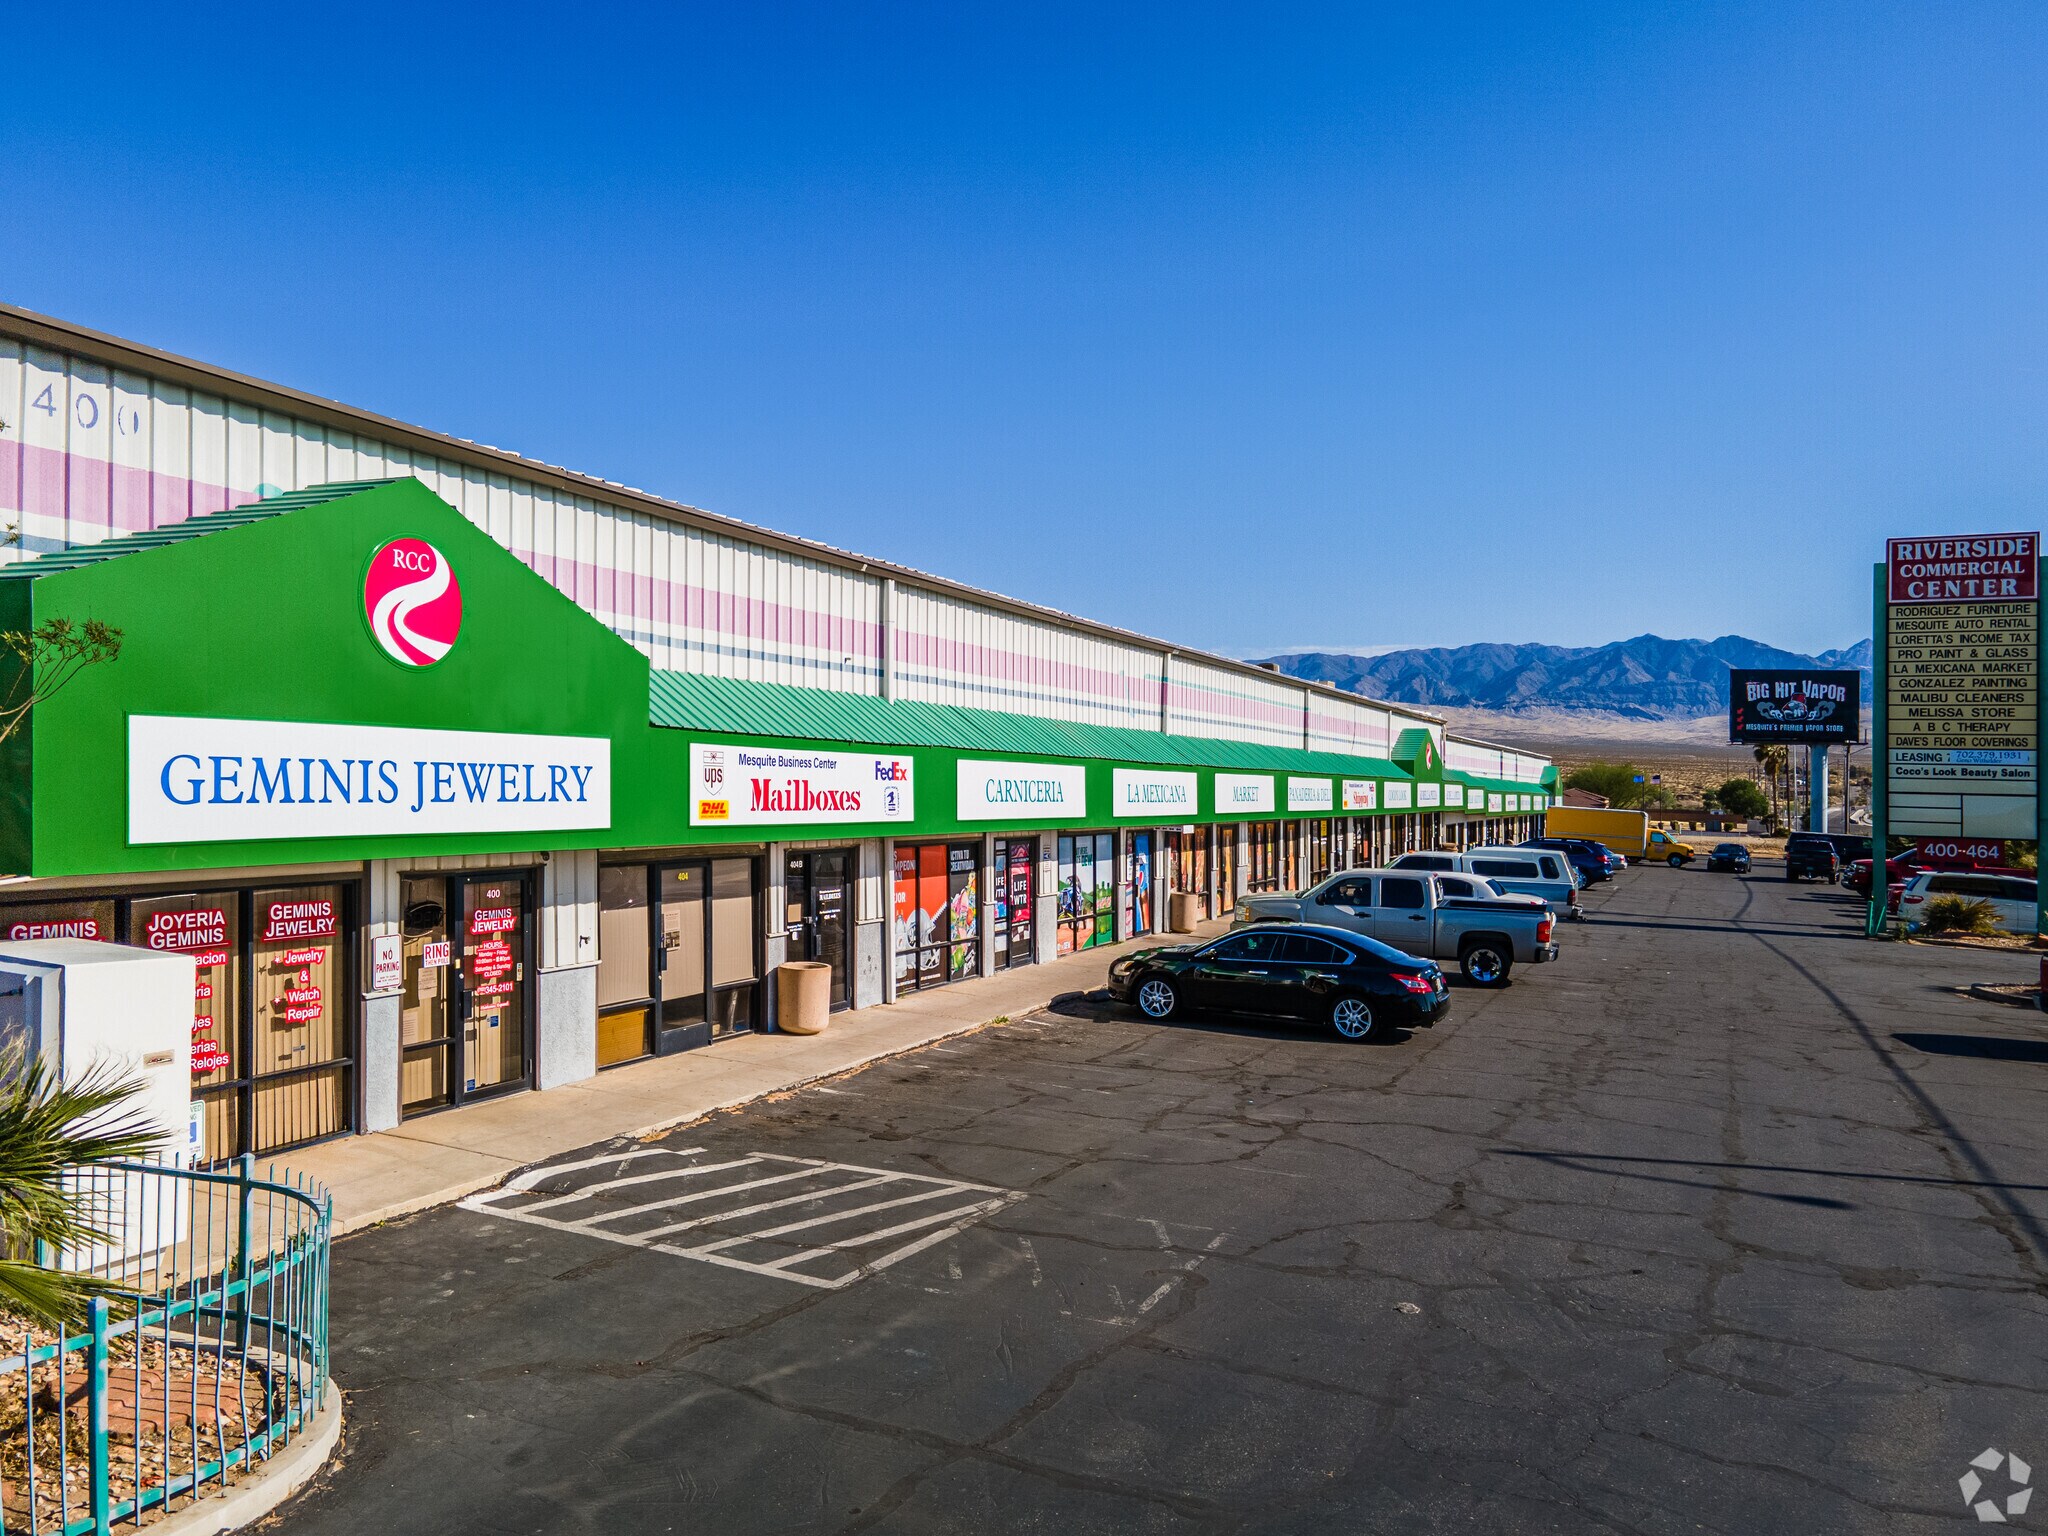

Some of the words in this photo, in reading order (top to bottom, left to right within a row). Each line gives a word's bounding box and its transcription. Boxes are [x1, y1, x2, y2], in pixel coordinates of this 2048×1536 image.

[1897, 538, 2030, 561] RIVERSIDE
[393, 549, 430, 572] RCC
[1900, 560, 2025, 578] COMMERCIAL
[1907, 578, 2018, 599] CENTER
[1895, 606, 1961, 617] RODRIGUEZ
[1967, 604, 2031, 615] FURNITURE
[1895, 620, 1949, 630] MESQUITE
[1955, 619, 1984, 629] AUTO
[1990, 618, 2030, 628] RENTAL
[1895, 634, 1953, 645] LORETTA'S
[1960, 634, 2003, 644] INCOME
[2009, 633, 2030, 643] TAX
[1898, 649, 1922, 659] PRO
[1929, 649, 1963, 659] PAINT
[1970, 649, 1978, 658] &
[1986, 648, 2028, 658] GLASS
[1894, 664, 1908, 674] LA
[1915, 663, 1976, 674] MEXICANA
[1982, 663, 2032, 673] MARKET
[1899, 678, 1965, 688] GONZALEZ
[1972, 678, 2028, 688] PAINTING
[1746, 681, 1770, 701] BIG
[1775, 682, 1797, 699] HIT
[1802, 680, 1846, 701] VAPOR
[1900, 693, 1948, 703] MALIBU
[1955, 693, 2024, 703] CLEANERS
[1908, 708, 1963, 717] MELISSA
[1971, 708, 2015, 717] STORE
[1913, 722, 1921, 731] A
[1928, 722, 1935, 731] B
[1942, 722, 1951, 732] C
[1957, 722, 2011, 732] THERAPY
[1896, 737, 1928, 746] DAVE'S
[1934, 737, 1966, 746] FLOOR
[1972, 737, 2028, 747] COVERINGS
[738, 753, 777, 770] Mesquite
[778, 755, 812, 769] Business
[813, 757, 837, 769] Center
[1895, 753, 1943, 762] LEASING
[704, 767, 723, 788] ups
[875, 761, 907, 781] FedEx
[1895, 767, 1929, 776] Coco's
[1933, 768, 1957, 776] Look
[1961, 768, 1998, 778] Beauty
[2001, 769, 2030, 778] Salon
[160, 754, 399, 805] GEMINIS
[411, 761, 593, 813] JEWELRY
[985, 778, 1064, 803] CARNICERIA
[750, 778, 861, 812] Mailboxes
[1127, 783, 1140, 803] LA
[1142, 784, 1187, 803] MEXICANA
[1233, 786, 1259, 802] MARKET
[702, 802, 726, 814] DHL
[677, 872, 689, 881] 404
[1013, 880, 1027, 892] LIFE
[486, 889, 501, 898] 400
[1014, 894, 1027, 905] WTR
[270, 902, 331, 920] GEMINIS
[474, 908, 512, 921] GEMINIS
[148, 911, 225, 931] JOYERIA
[265, 917, 335, 938] JEWELRY
[472, 918, 515, 933] JEWELRY
[11, 921, 97, 940] GEMINIS
[150, 927, 224, 949] GEMINIS
[483, 941, 503, 949] HOURS
[285, 949, 323, 965] Jewelry
[383, 950, 393, 960] NO
[425, 943, 449, 959] RING
[376, 961, 399, 973] PARKING
[300, 970, 309, 981] &
[288, 988, 320, 1002] Watch
[287, 1005, 321, 1022] Repair
[191, 1055, 229, 1070] Relojes
